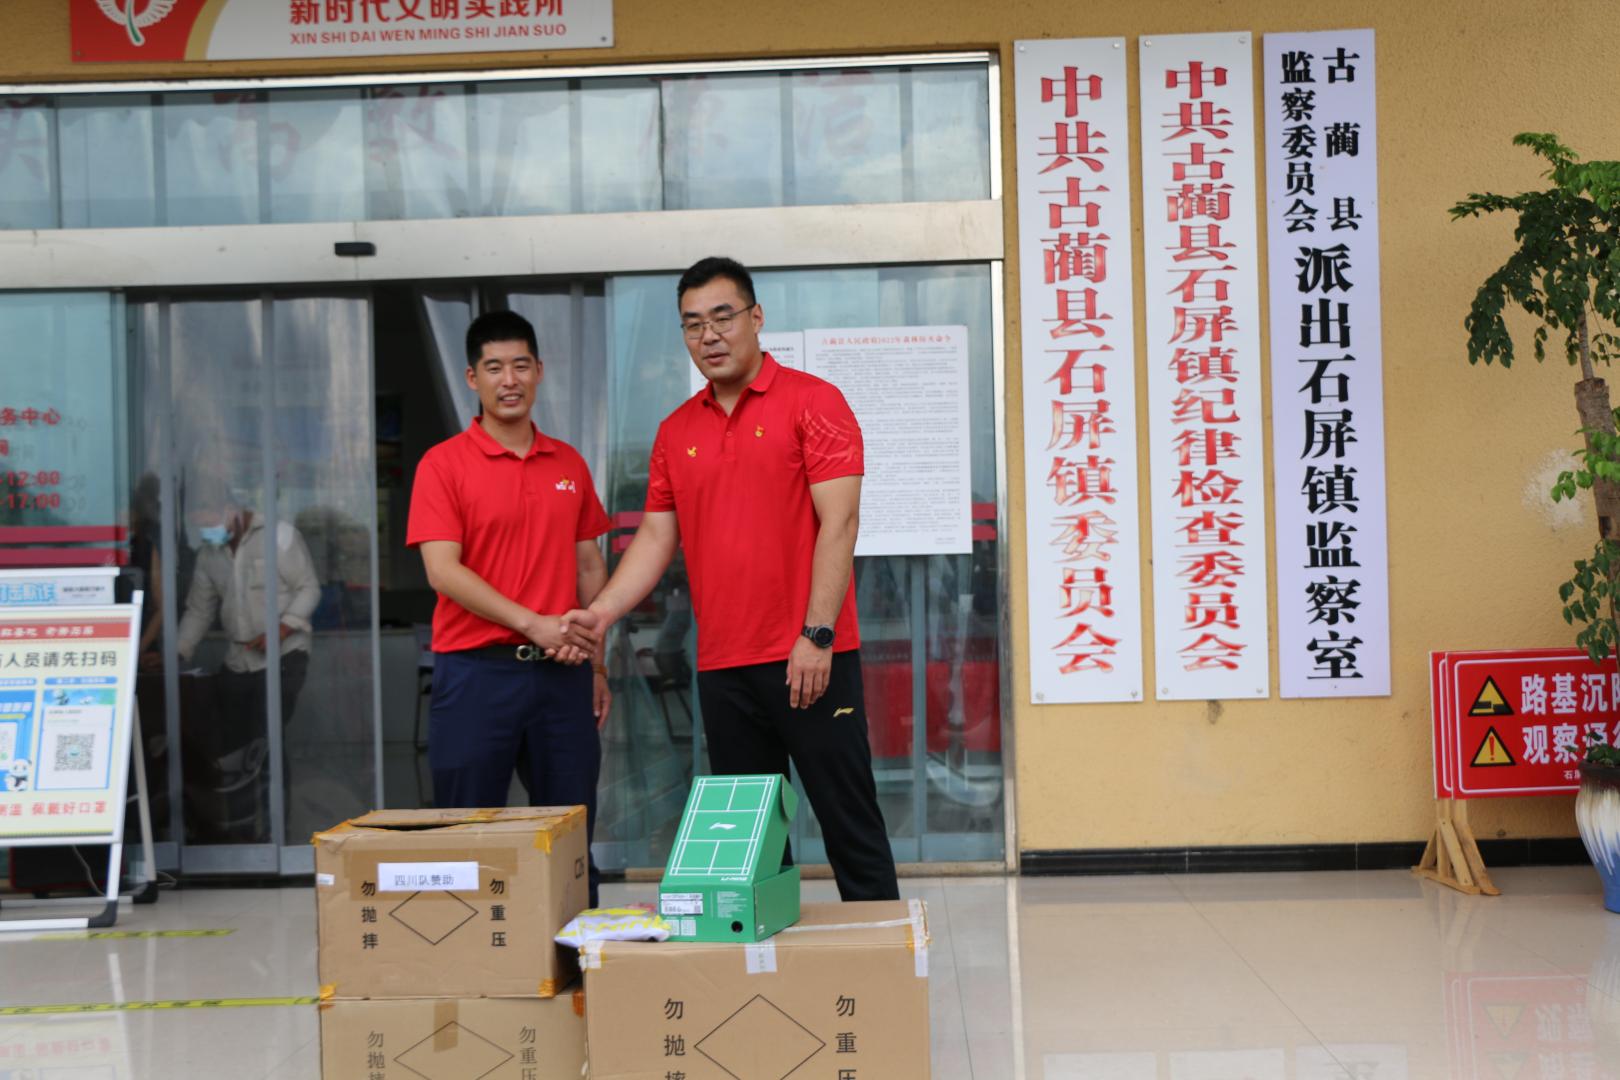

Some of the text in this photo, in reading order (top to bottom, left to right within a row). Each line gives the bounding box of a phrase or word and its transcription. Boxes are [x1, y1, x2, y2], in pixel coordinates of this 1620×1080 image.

[290, 23, 567, 44] XIN SHI DAI WEN MING SHI JIAN SUO
[1279, 51, 1319, 233] 监察委员会
[1322, 47, 1362, 231] 古蔺县
[1037, 66, 1122, 675] 中共古蔺县石屏镇委员会
[1161, 60, 1248, 672] 中共古蔺县石屏镇纪律检查委员会
[1295, 243, 1364, 680] 派出石屏镇监察室
[0, 651, 117, 668] 人员请先扫码
[489, 878, 507, 947] 勿重压
